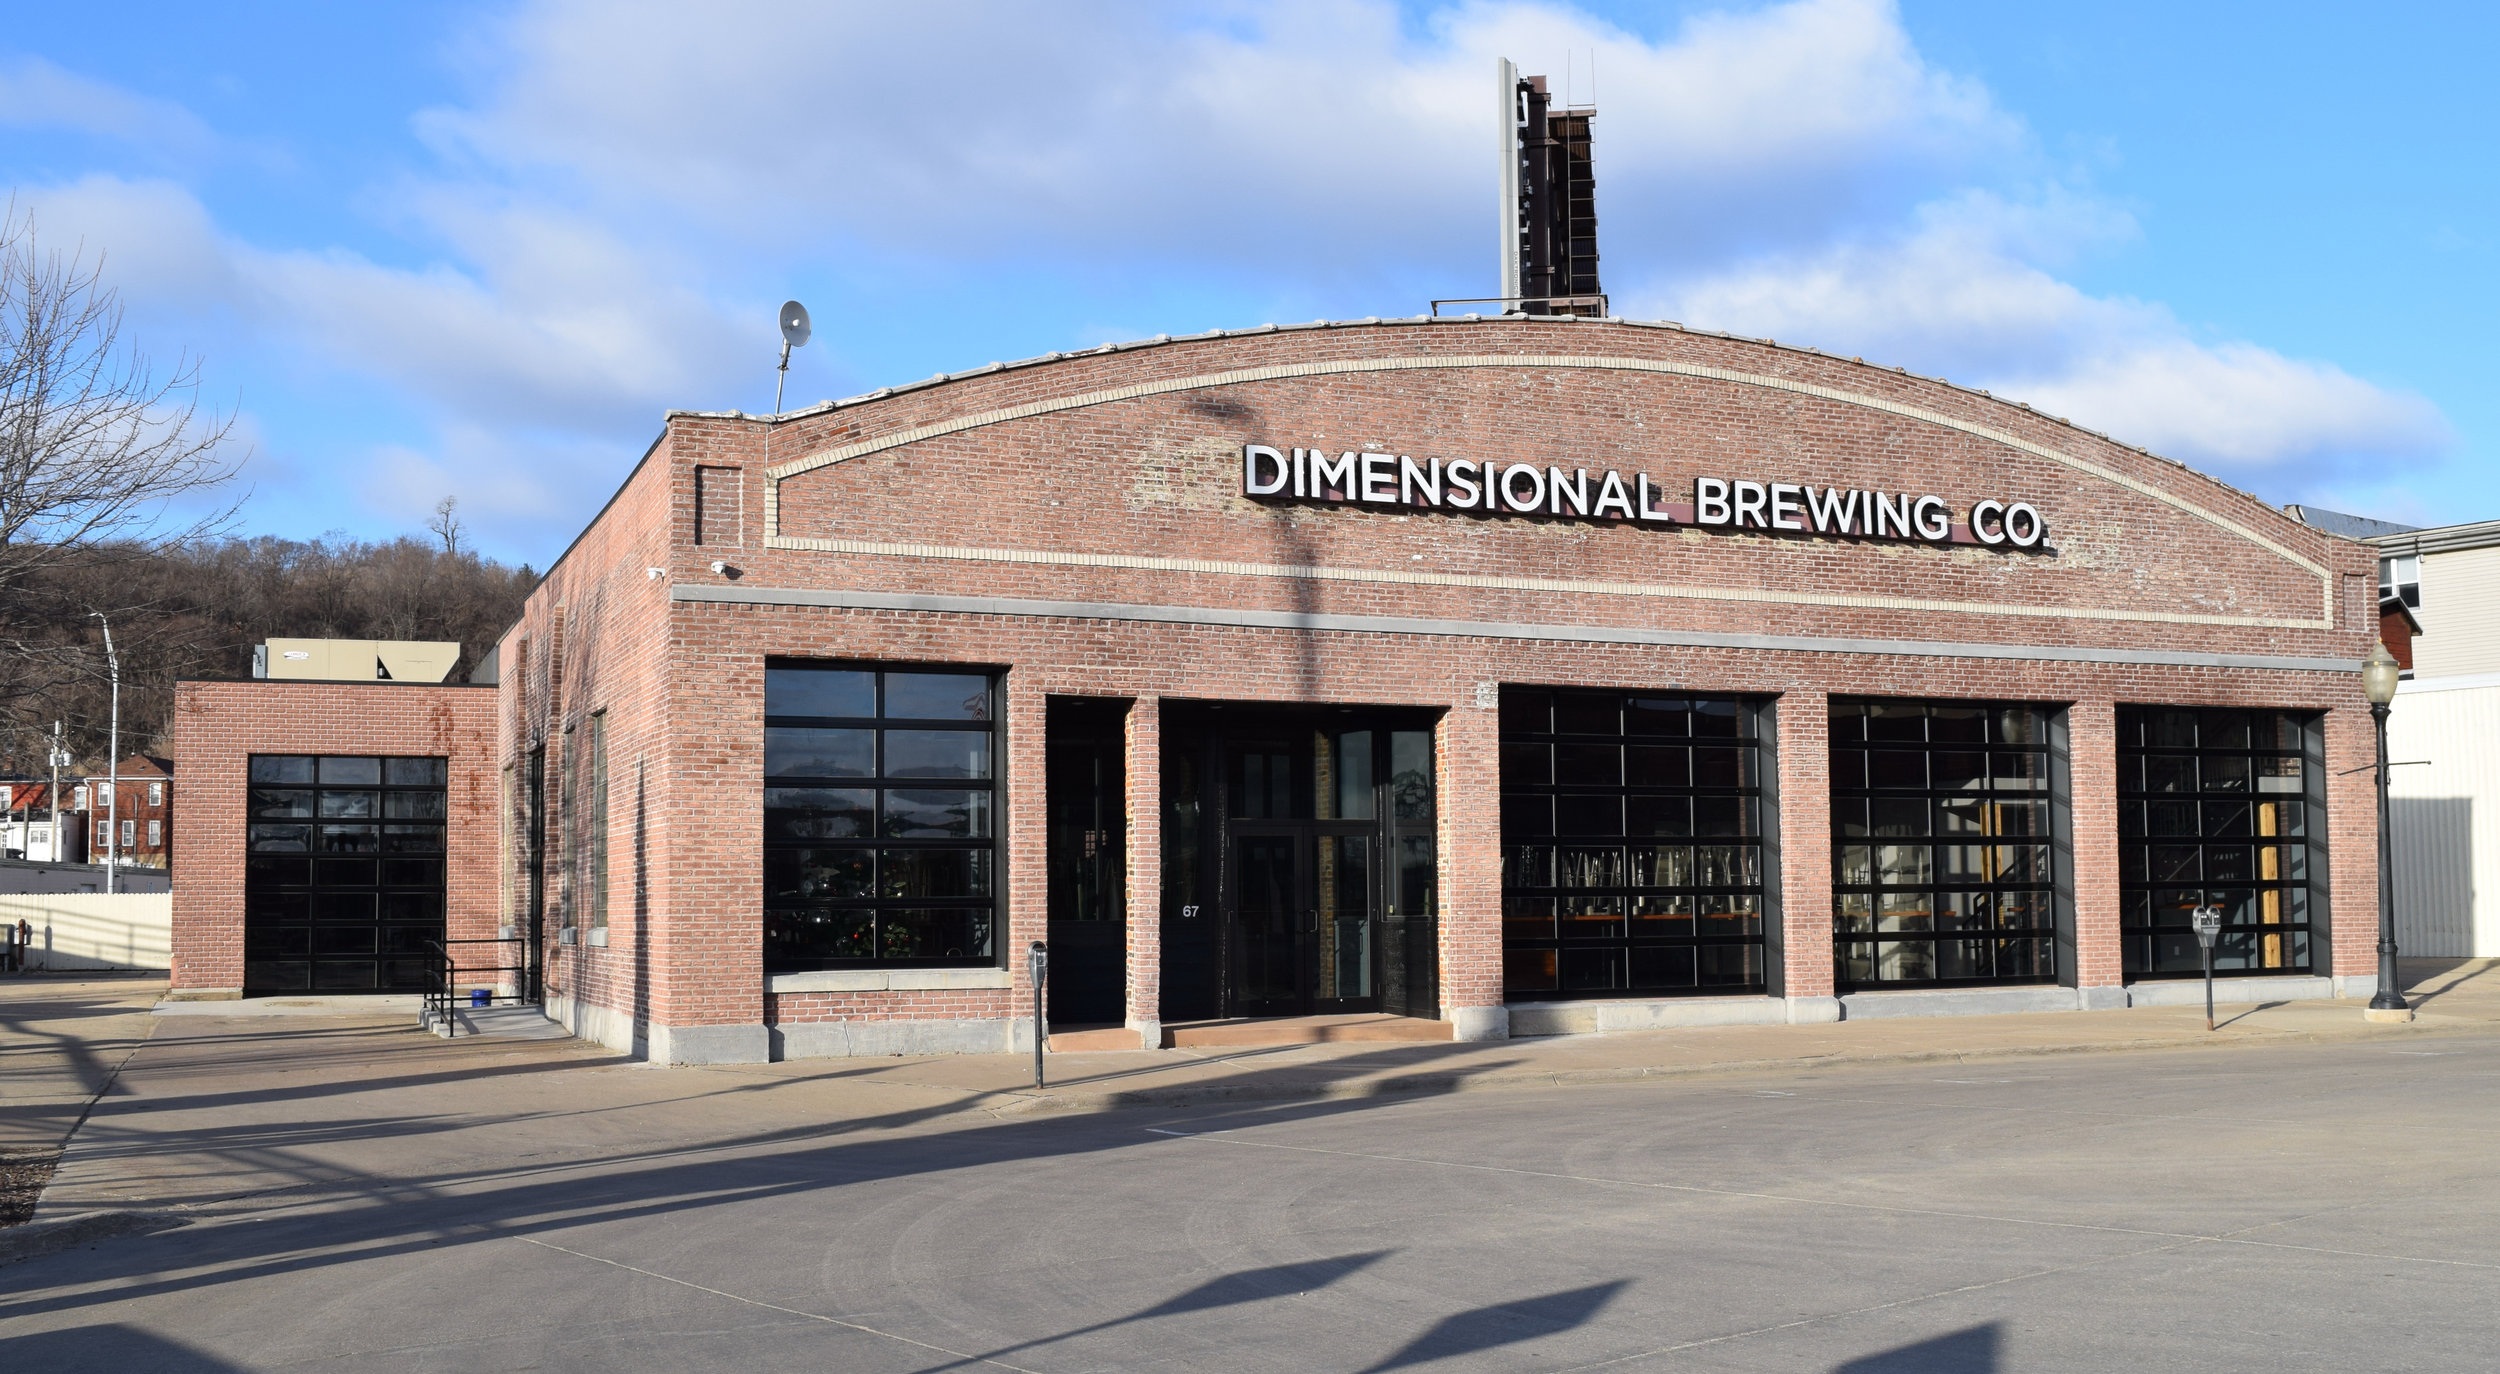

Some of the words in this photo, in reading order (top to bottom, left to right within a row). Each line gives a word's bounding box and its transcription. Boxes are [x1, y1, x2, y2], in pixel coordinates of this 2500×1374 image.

[1244, 444, 1669, 521] DIMENSIONAL
[1696, 477, 1949, 540] BREWING
[1971, 499, 2050, 547] CO.
[1183, 905, 1200, 918] 67
